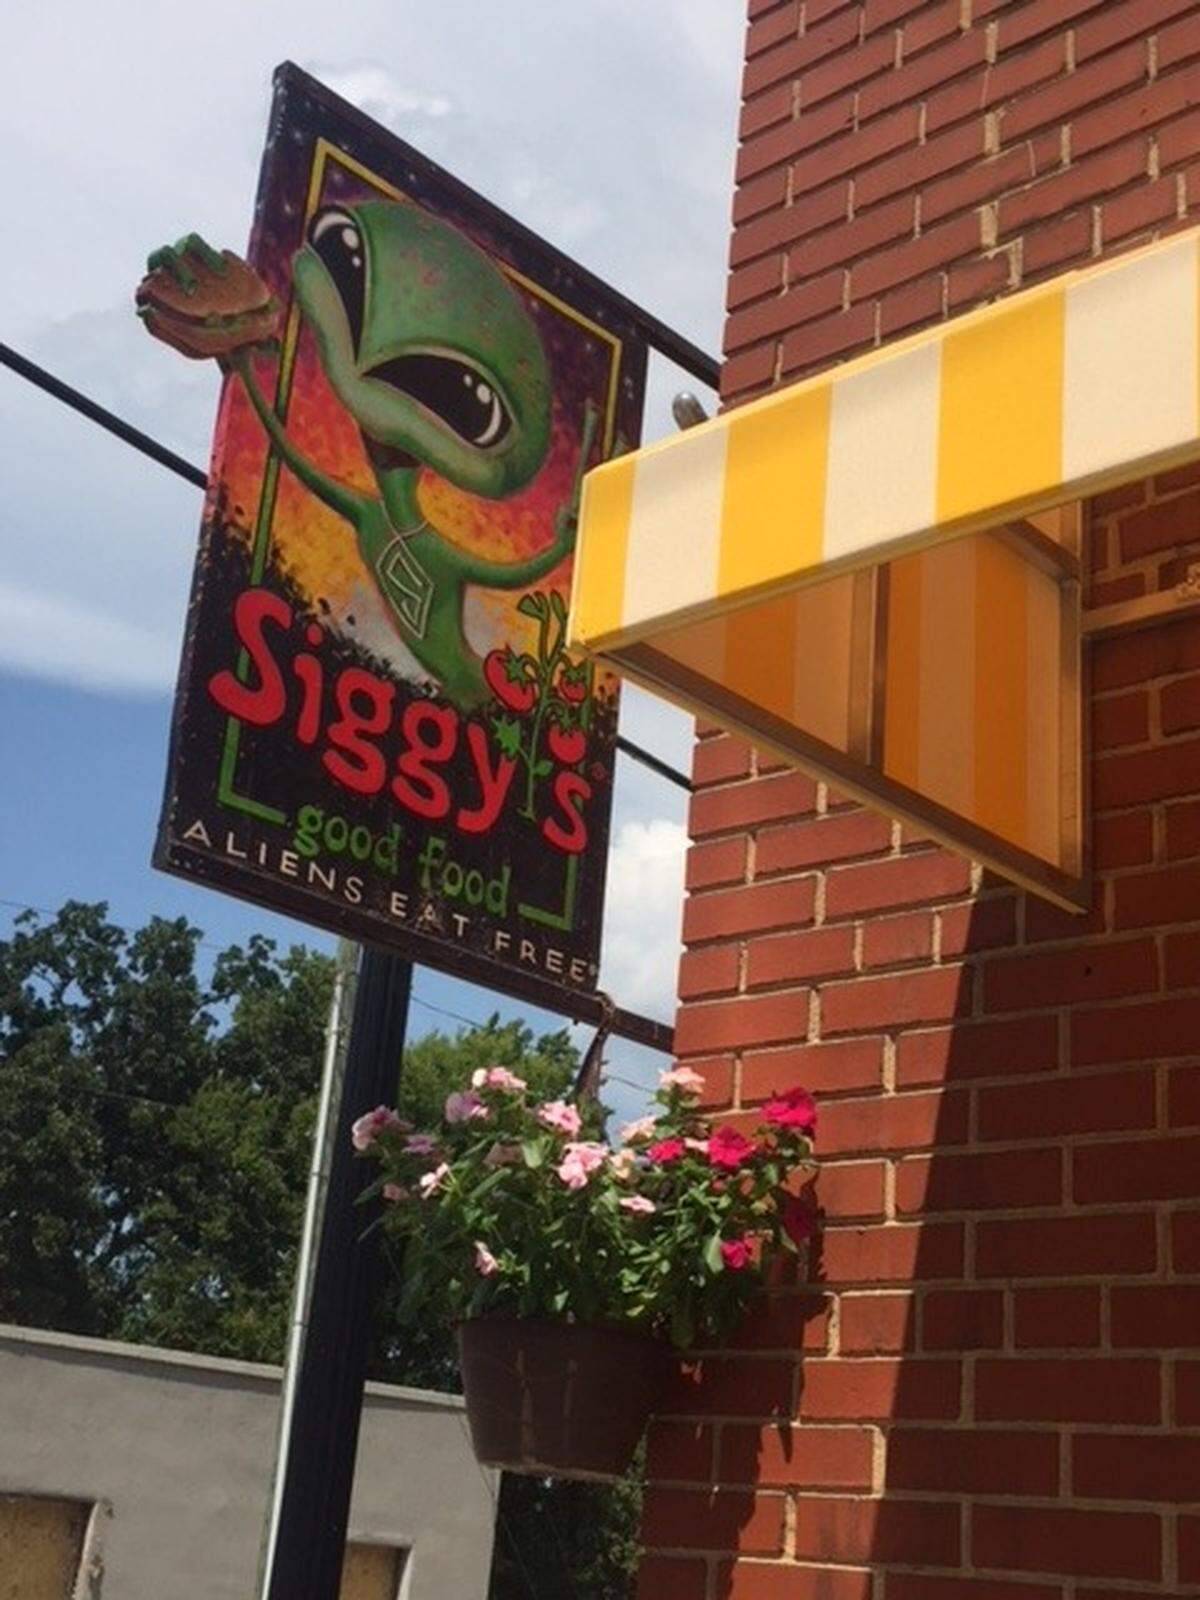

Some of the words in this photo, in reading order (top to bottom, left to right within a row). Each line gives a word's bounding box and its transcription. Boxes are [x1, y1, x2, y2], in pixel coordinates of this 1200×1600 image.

[183, 819, 364, 904] ALIENS
[390, 891, 470, 932] EAT
[494, 930, 589, 983] FREE
[292, 804, 402, 874] good
[418, 836, 512, 918] food
